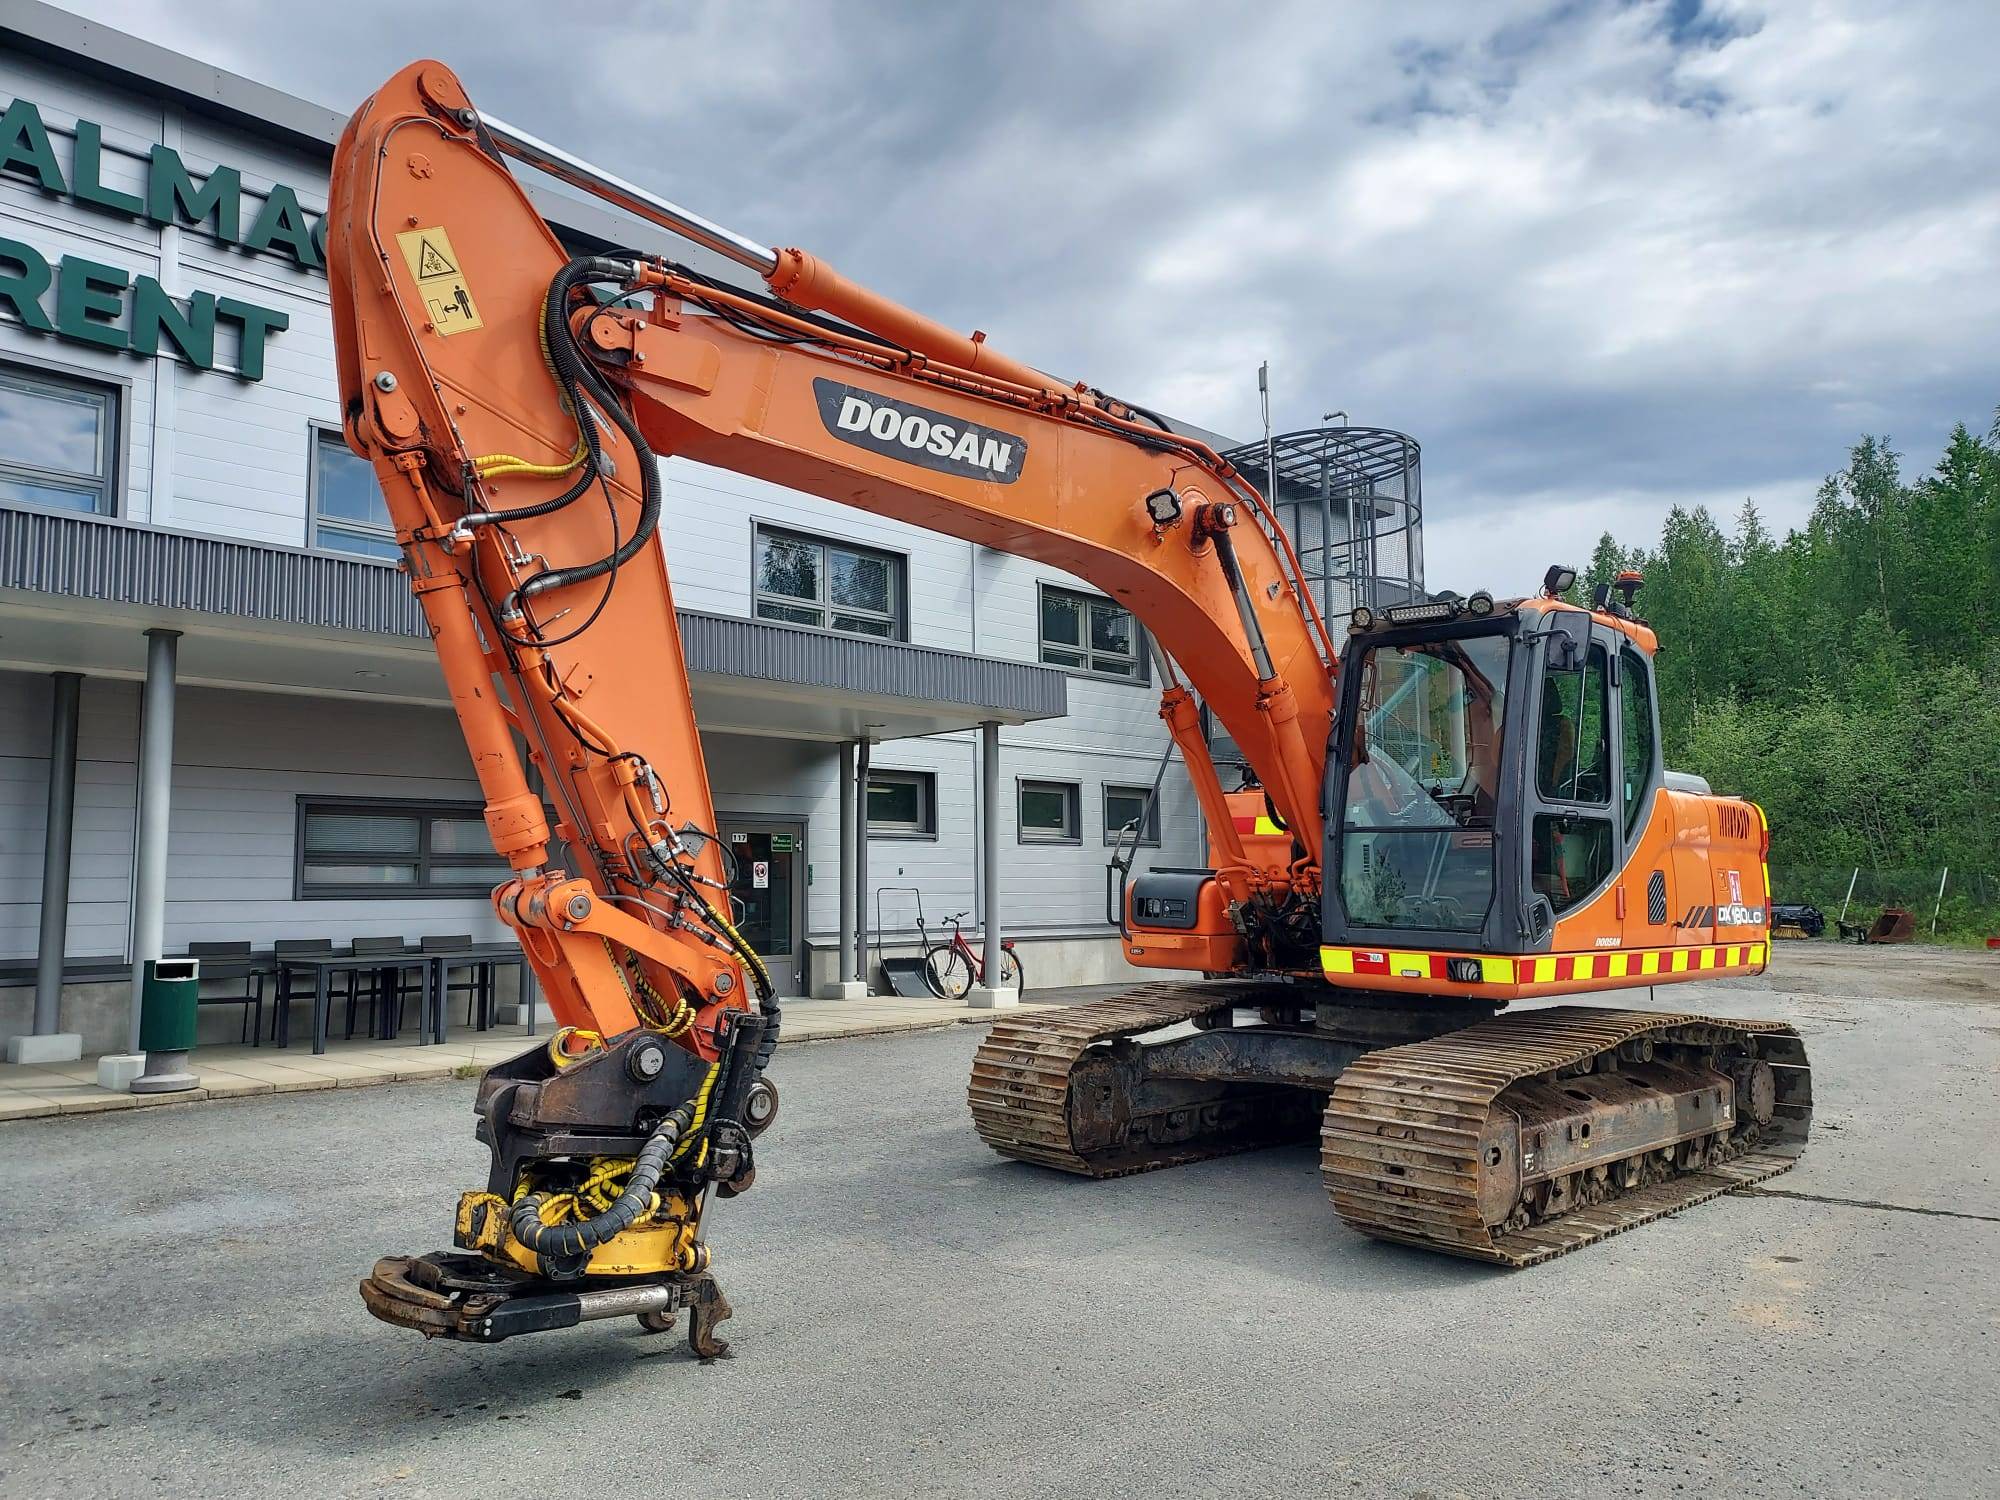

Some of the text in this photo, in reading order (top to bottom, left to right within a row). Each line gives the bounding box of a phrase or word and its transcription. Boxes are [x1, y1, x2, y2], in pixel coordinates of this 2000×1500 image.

[0, 98, 328, 268] ALMA
[0, 236, 290, 381] RENT
[837, 396, 1012, 473] DOOSAN
[1594, 937, 1622, 947] DOOSAN
